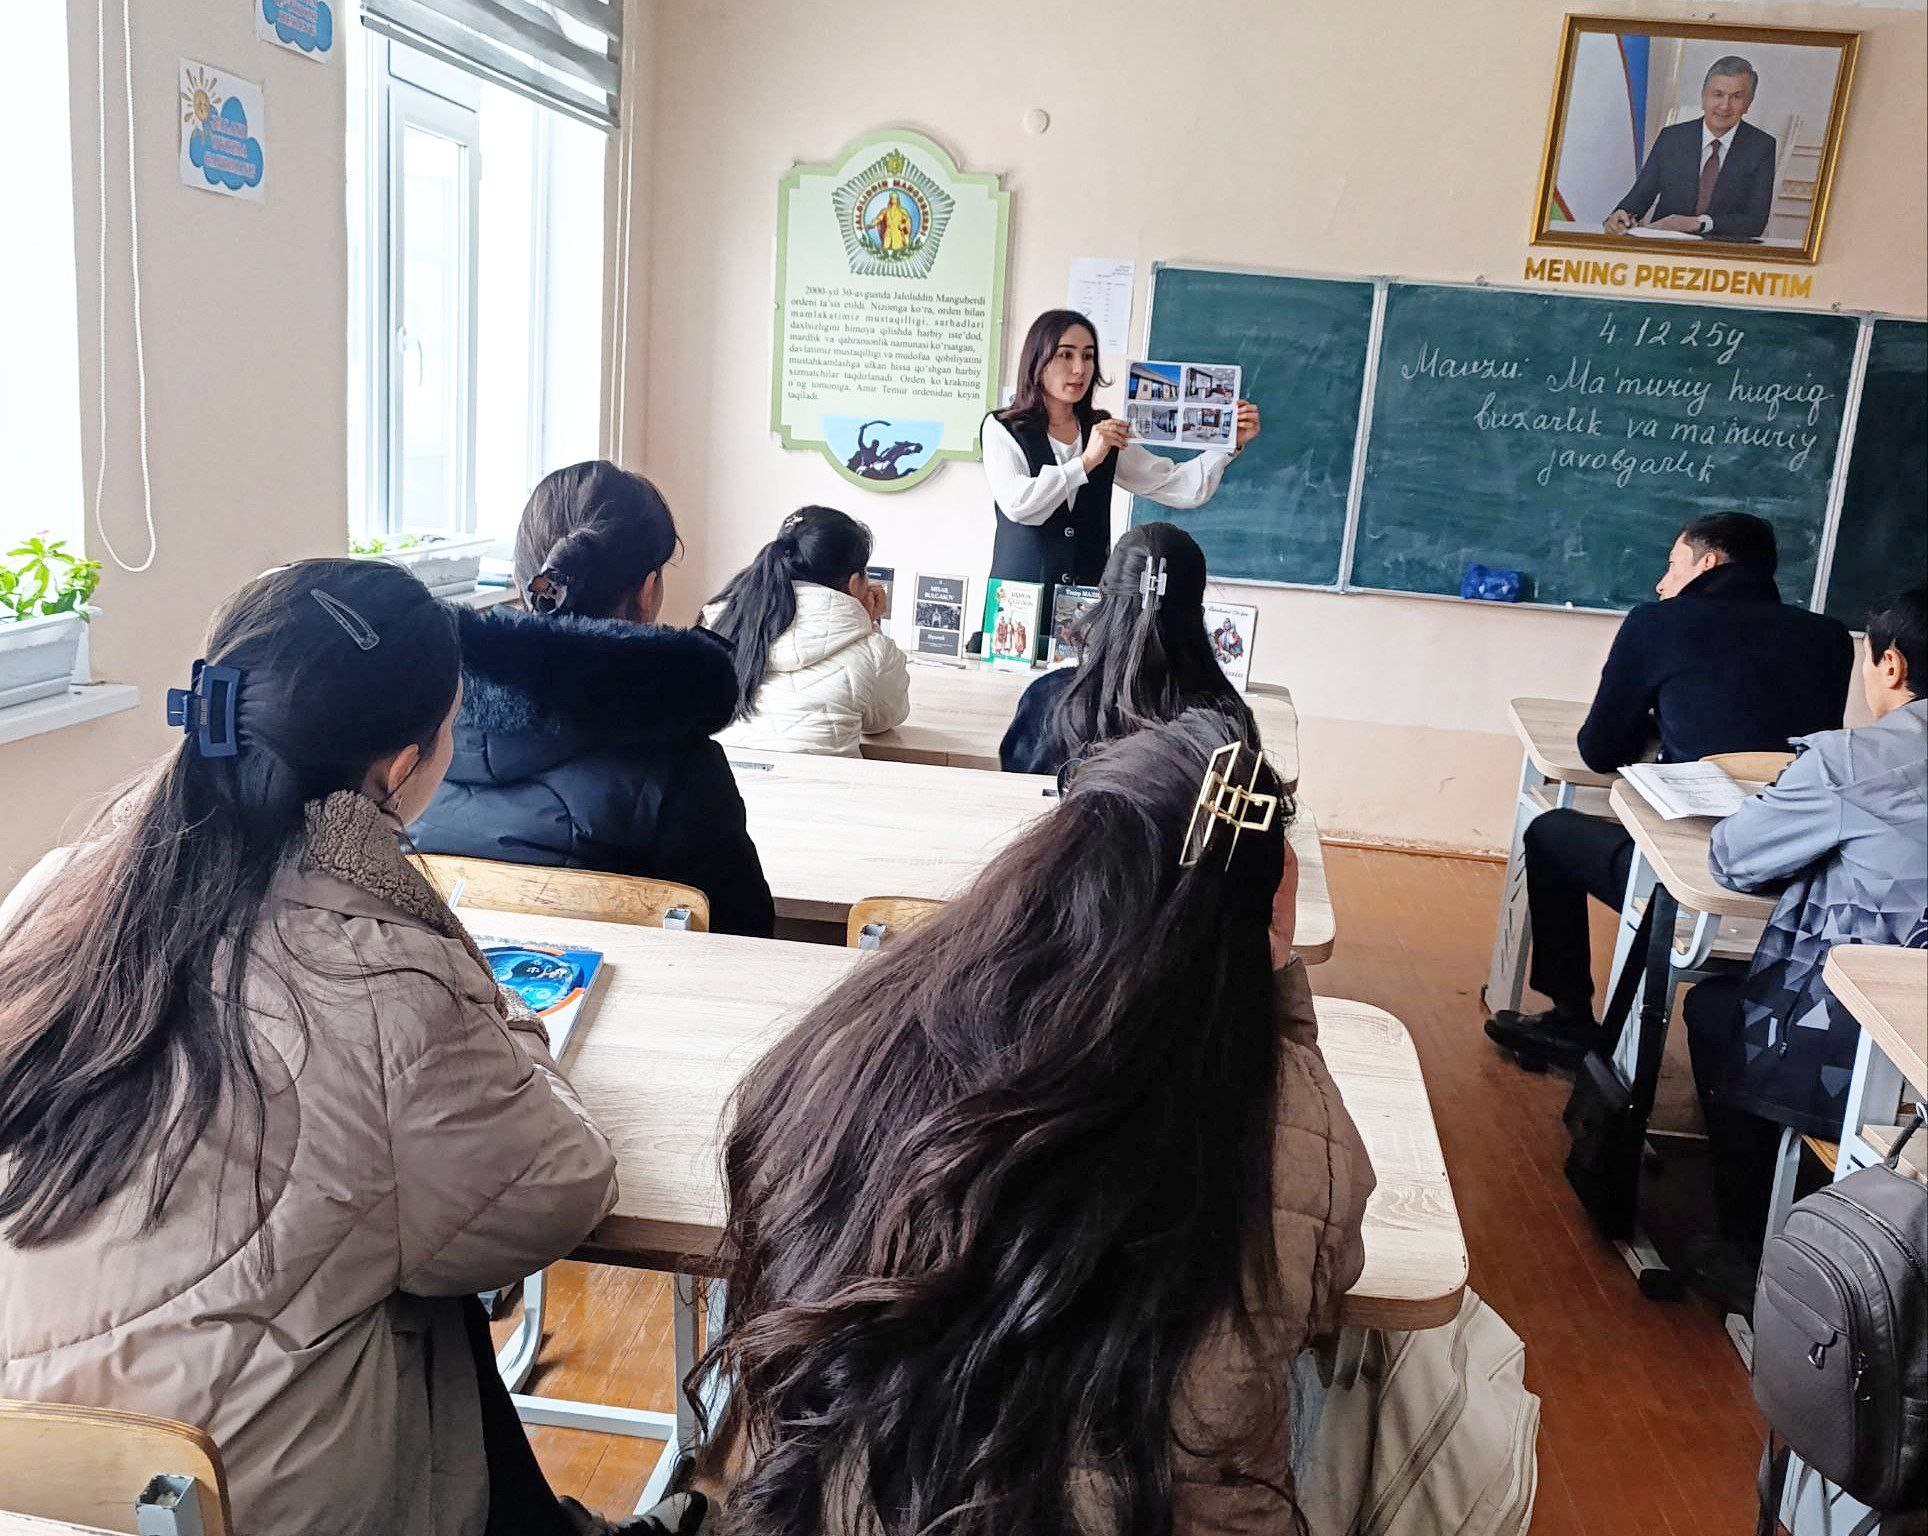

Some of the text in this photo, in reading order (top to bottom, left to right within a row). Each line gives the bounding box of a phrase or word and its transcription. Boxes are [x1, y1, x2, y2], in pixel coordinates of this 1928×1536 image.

[1525, 256, 1814, 298] MENING PREZIDENTIM
[1627, 417, 1659, 439] va
